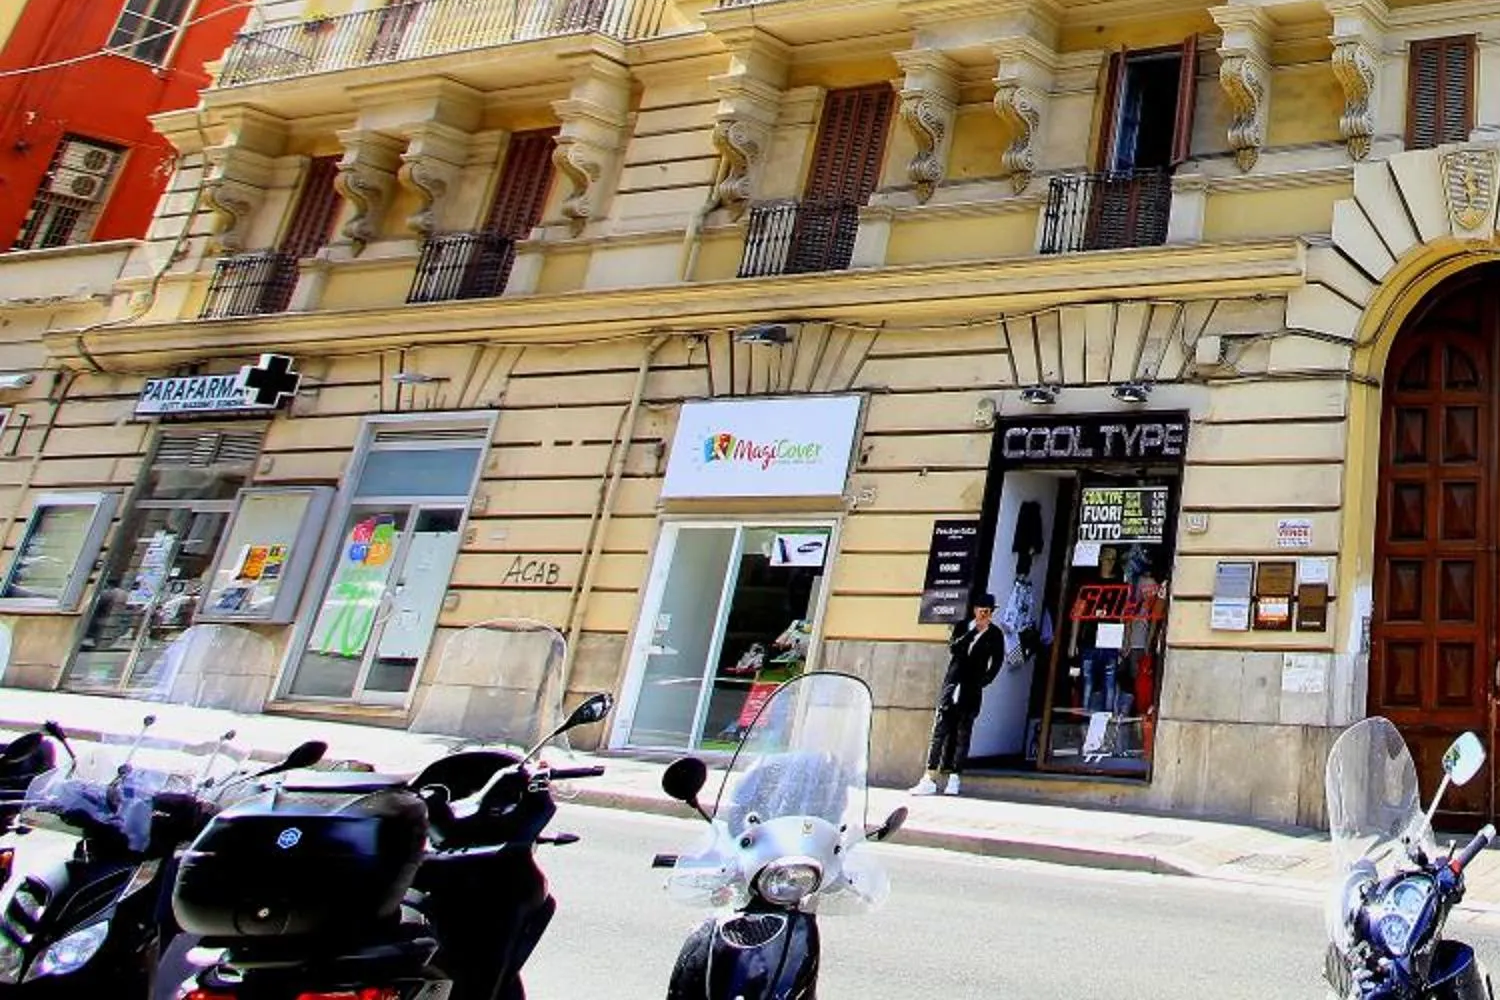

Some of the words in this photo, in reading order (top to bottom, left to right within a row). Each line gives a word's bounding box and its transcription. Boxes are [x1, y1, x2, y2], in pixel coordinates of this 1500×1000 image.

[1002, 425, 1093, 459] COOL
[1099, 423, 1183, 457] TYPE
[1083, 505, 1123, 522] FUORI
[1080, 523, 1121, 540] TUTTO
[501, 555, 560, 585] ACAB
